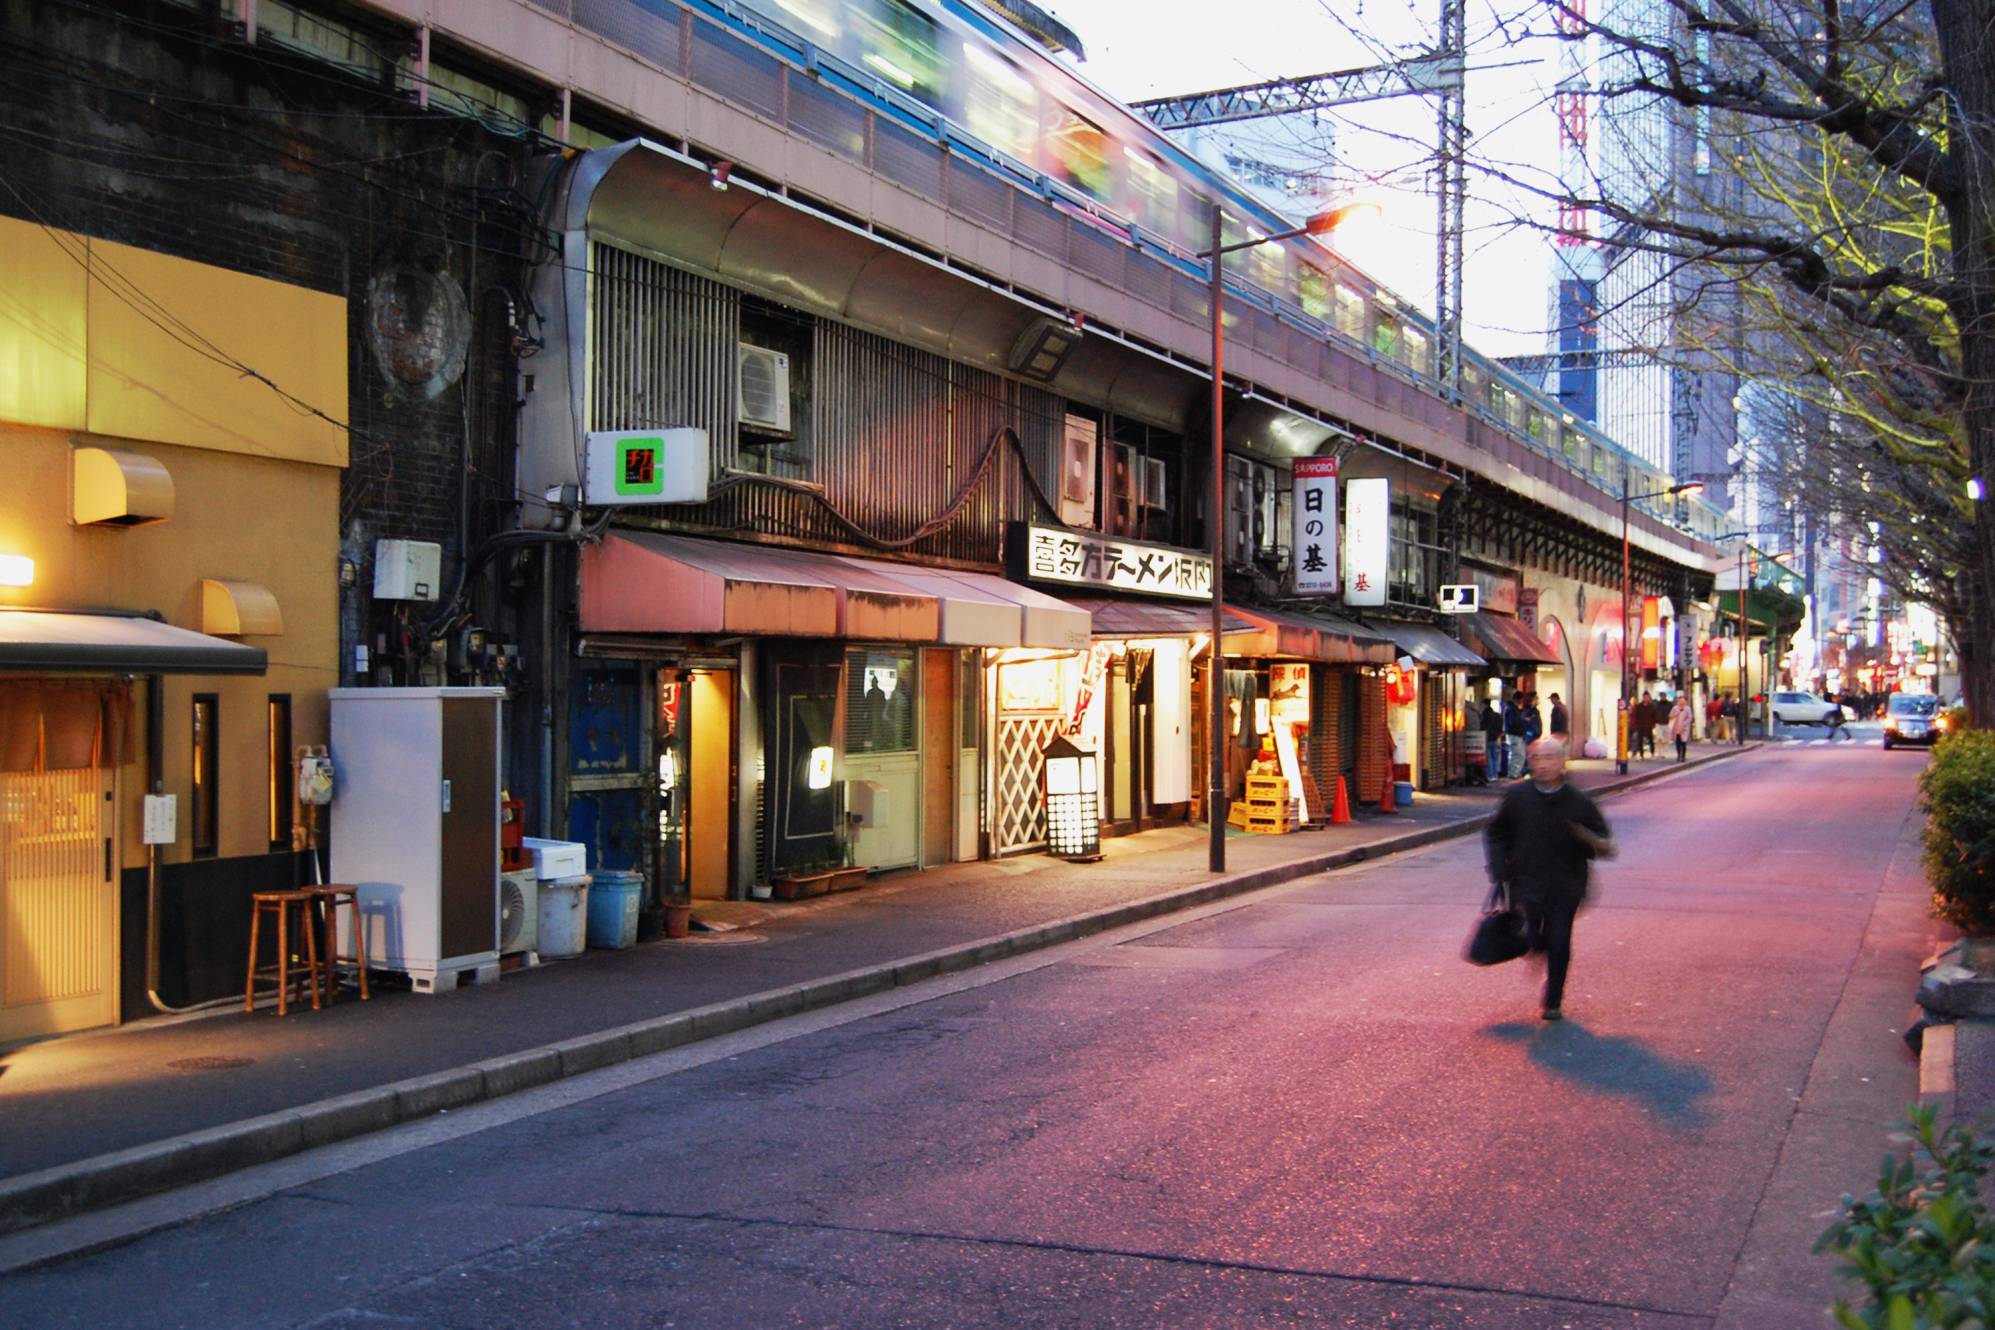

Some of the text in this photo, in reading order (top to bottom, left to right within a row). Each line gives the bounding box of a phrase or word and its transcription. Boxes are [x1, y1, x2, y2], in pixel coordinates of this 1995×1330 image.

[1295, 463, 1333, 473] SAPPORO
[1302, 487, 1328, 573] 日の基
